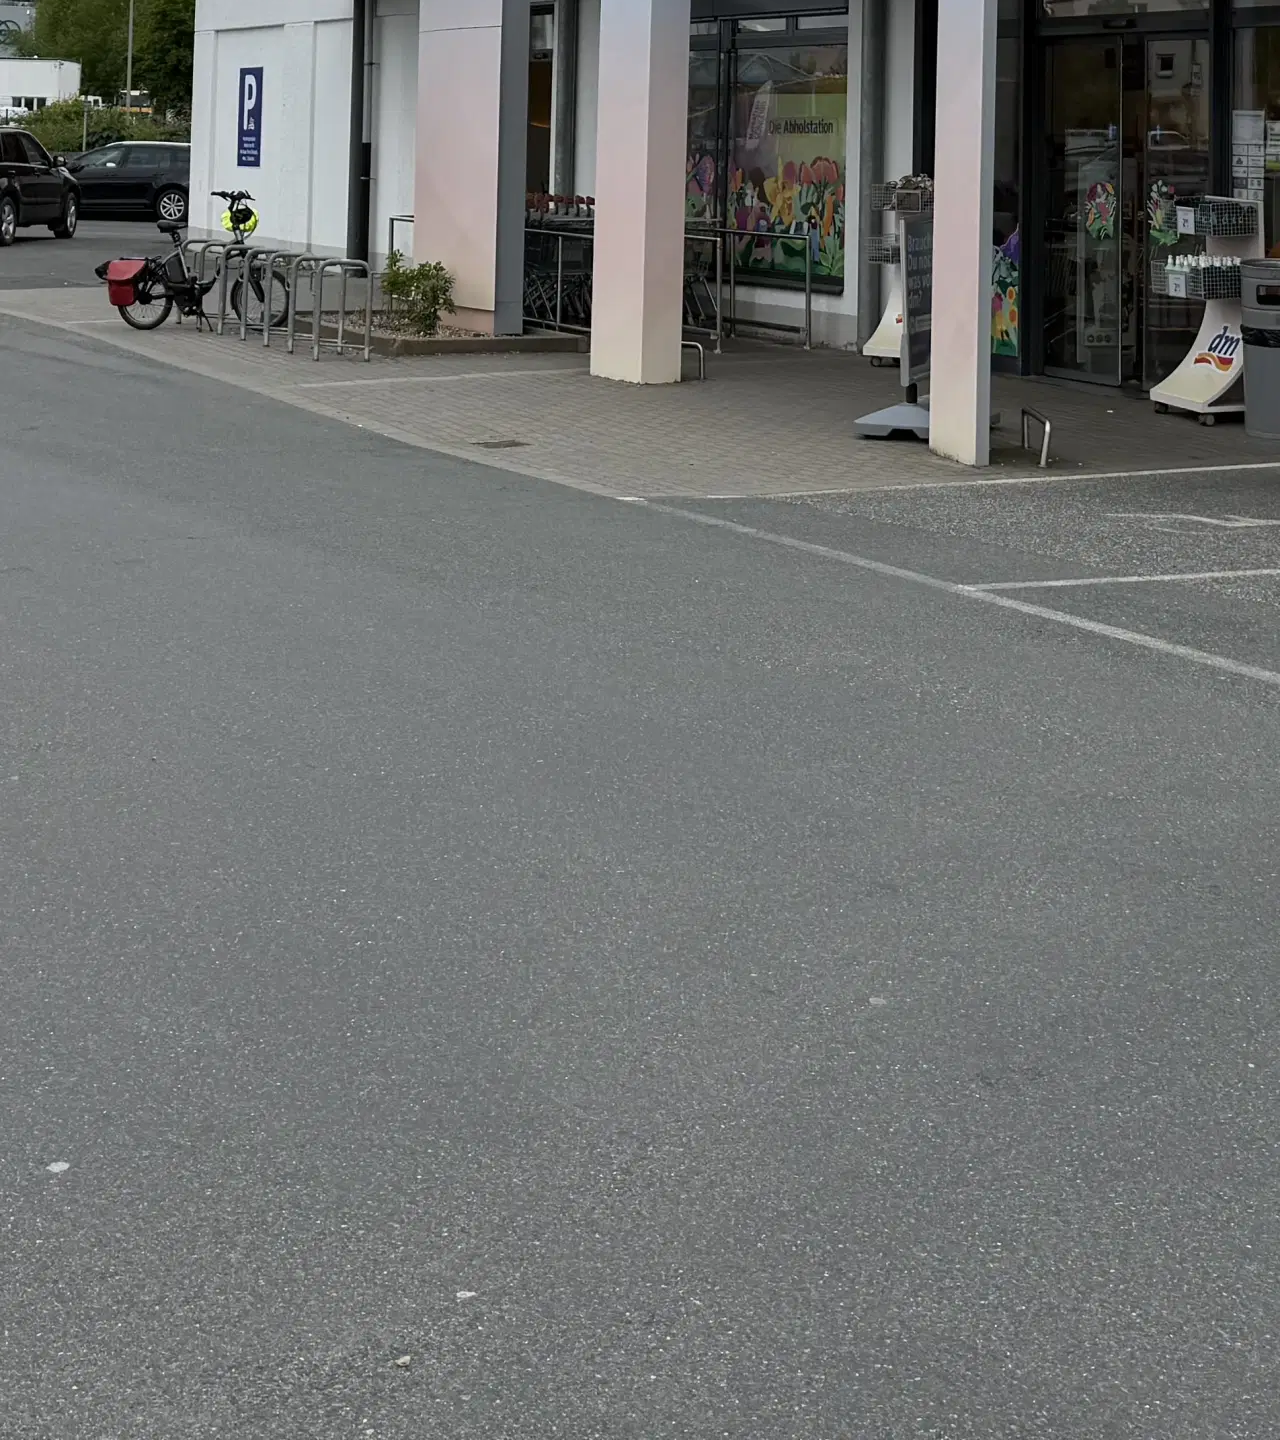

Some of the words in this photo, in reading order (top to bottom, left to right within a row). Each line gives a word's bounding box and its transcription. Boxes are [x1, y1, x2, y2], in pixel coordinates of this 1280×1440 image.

[243, 74, 257, 130] P
[769, 120, 781, 135] Die
[783, 118, 834, 134] Abholstation
[1207, 325, 1241, 356] dm
